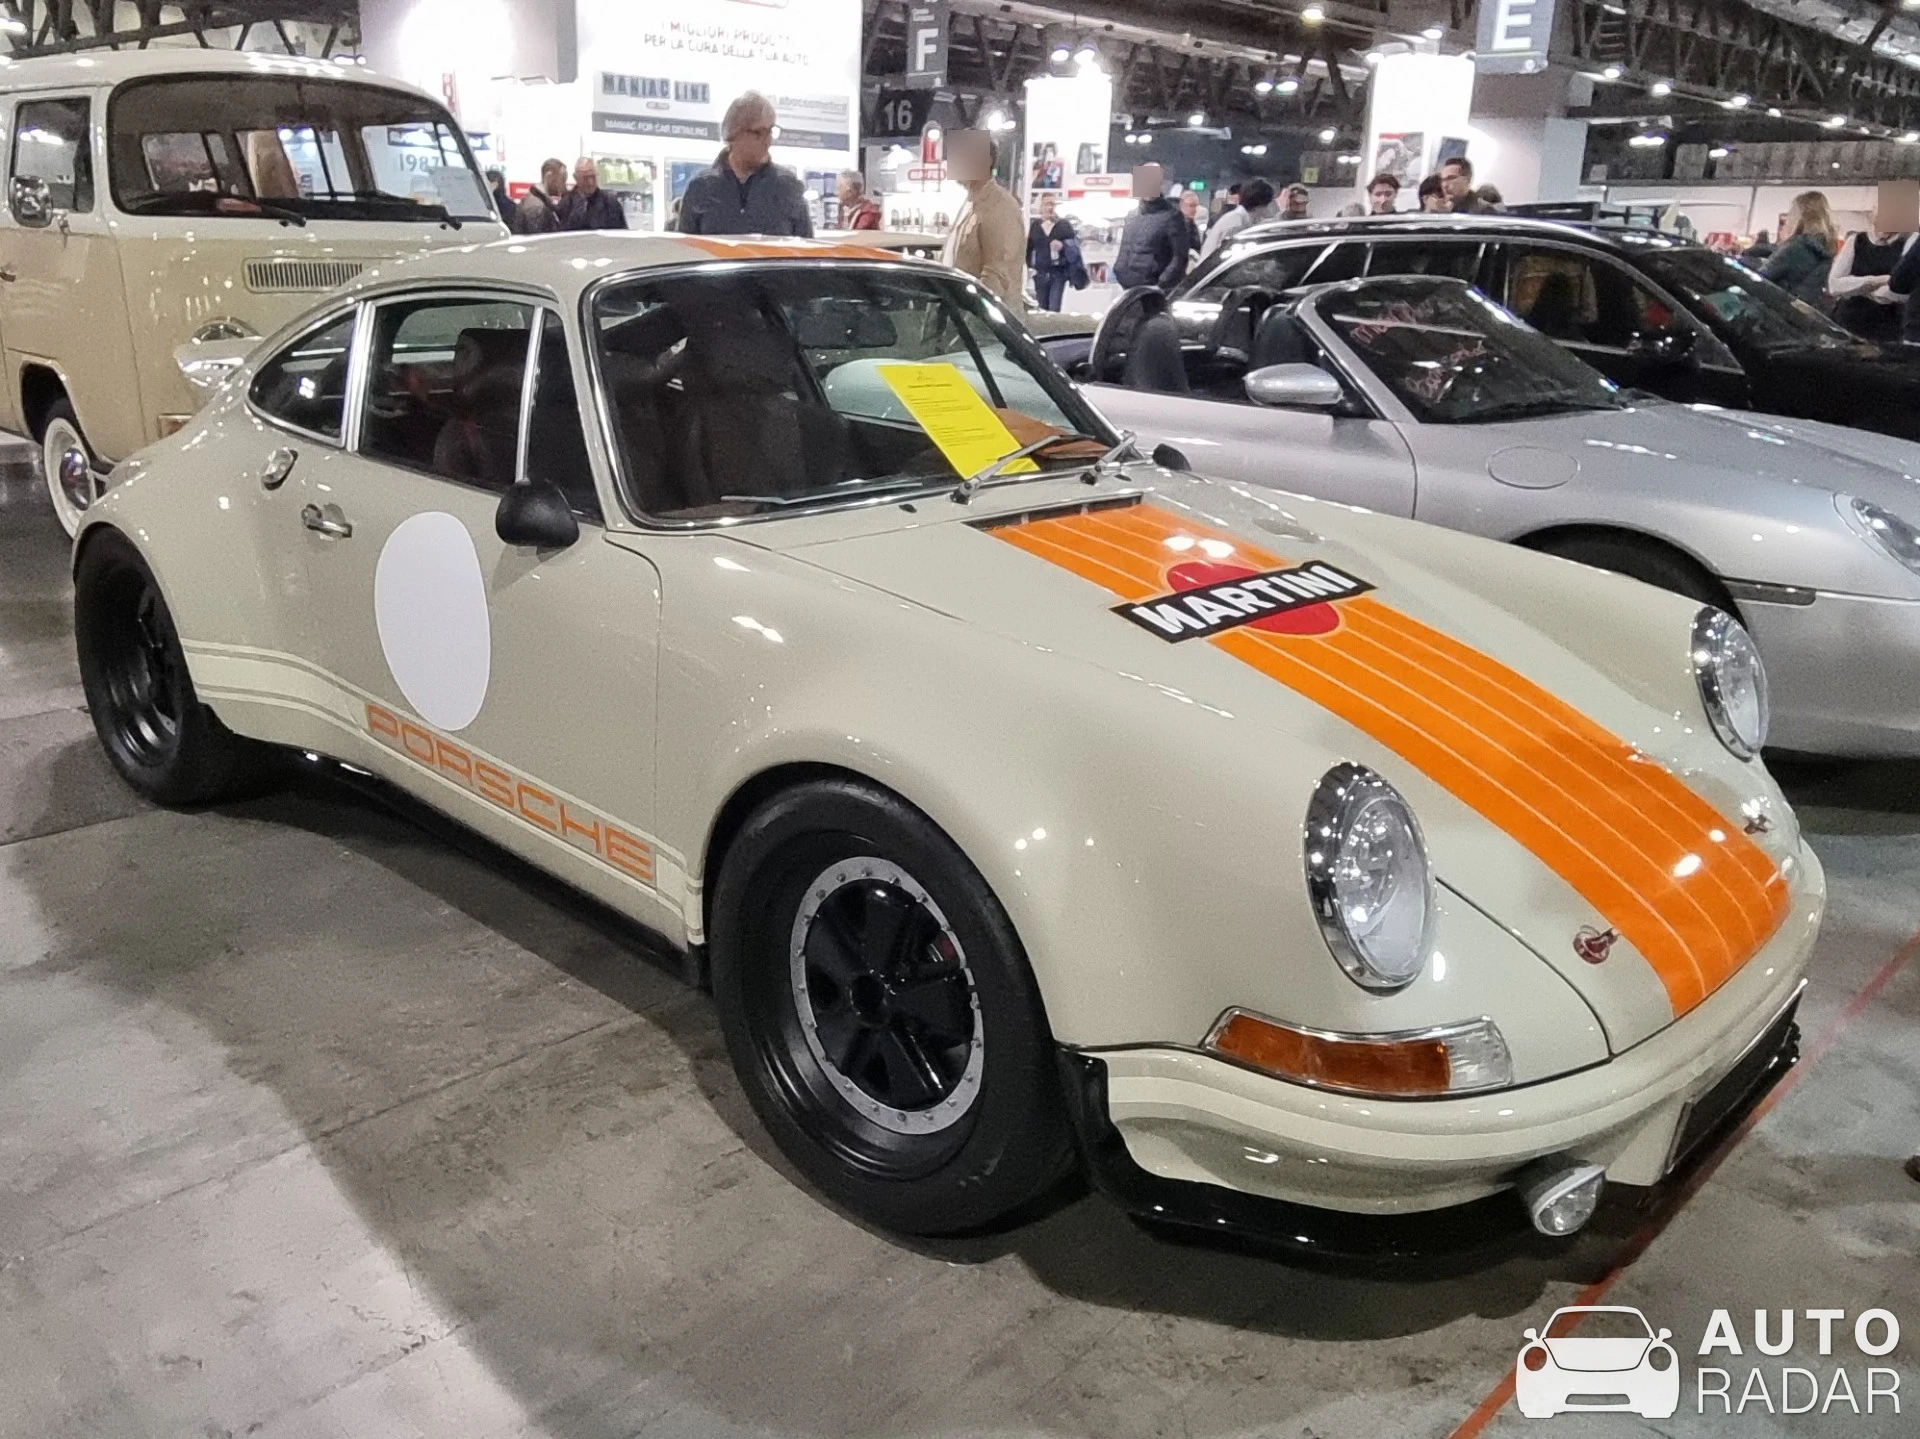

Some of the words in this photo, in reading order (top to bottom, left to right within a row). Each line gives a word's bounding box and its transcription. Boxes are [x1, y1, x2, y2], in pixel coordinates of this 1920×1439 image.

[644, 33, 666, 47] PER
[671, 38, 684, 50] LA
[688, 39, 718, 55] CURA
[1492, 0, 1537, 51] E
[915, 28, 939, 71] F
[602, 72, 670, 99] MANIAC
[674, 80, 710, 104] LINE
[638, 121, 654, 133] FOR
[655, 124, 671, 134] CAR
[884, 99, 912, 131] 16
[1131, 564, 1359, 635] MARTINI
[366, 702, 654, 882] PORSCHE
